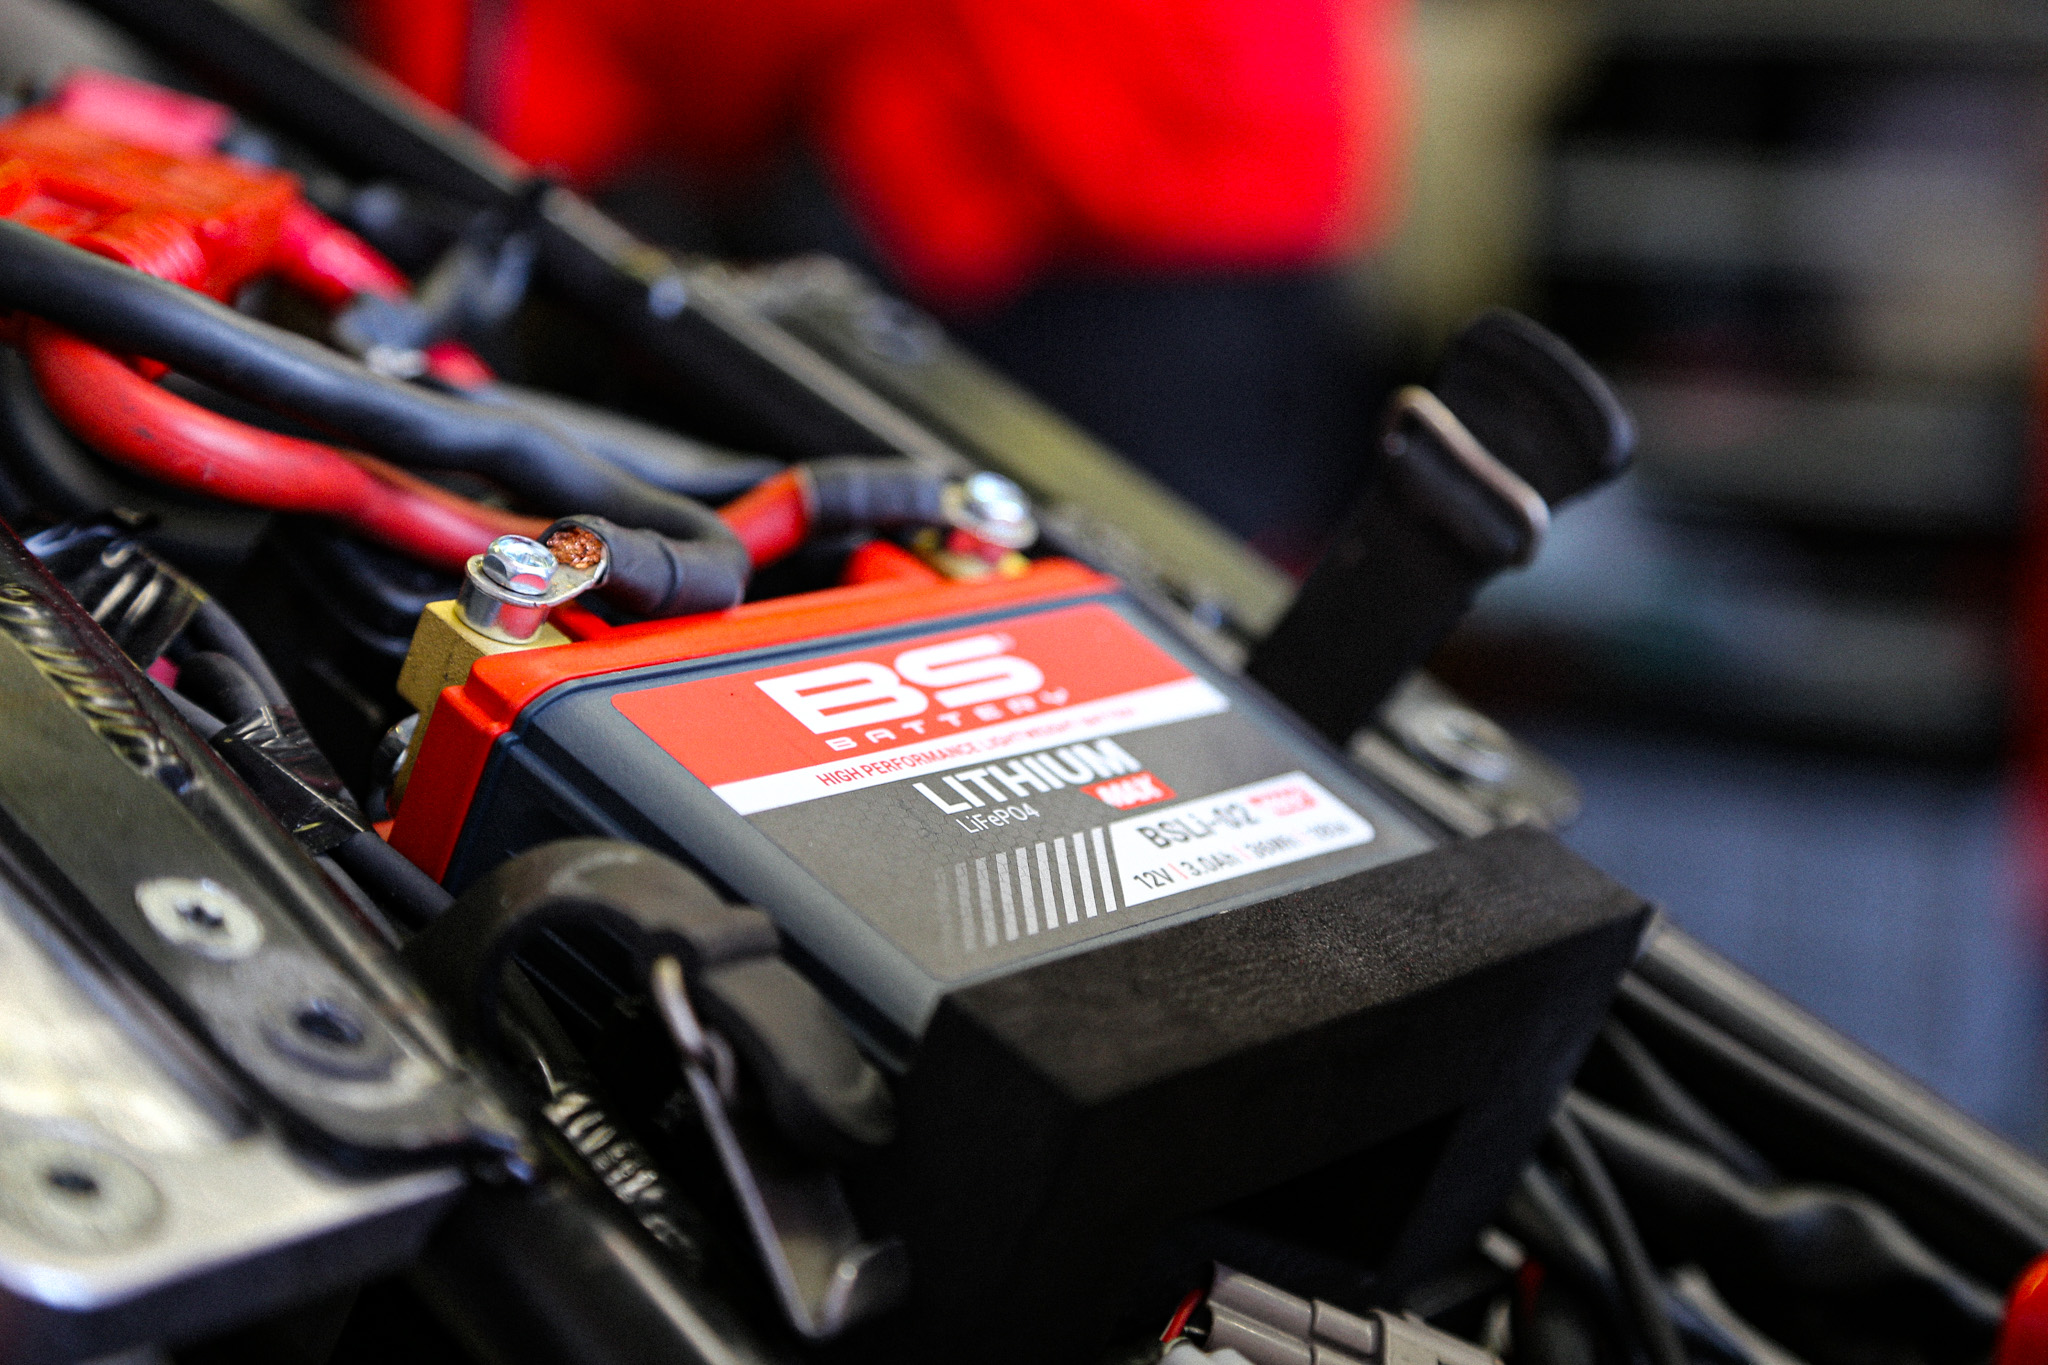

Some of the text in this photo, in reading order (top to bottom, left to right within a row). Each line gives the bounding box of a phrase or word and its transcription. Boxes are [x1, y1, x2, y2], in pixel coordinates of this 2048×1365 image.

[754, 634, 1044, 734] BS
[825, 686, 1069, 751] BATTERY
[816, 764, 865, 786] HIGH
[860, 742, 977, 777] PERFORMANCE
[912, 738, 1142, 814] LITHIUM
[1095, 774, 1163, 807] MAX
[956, 803, 1040, 833] LiFePO4
[1133, 867, 1174, 889] 12V
